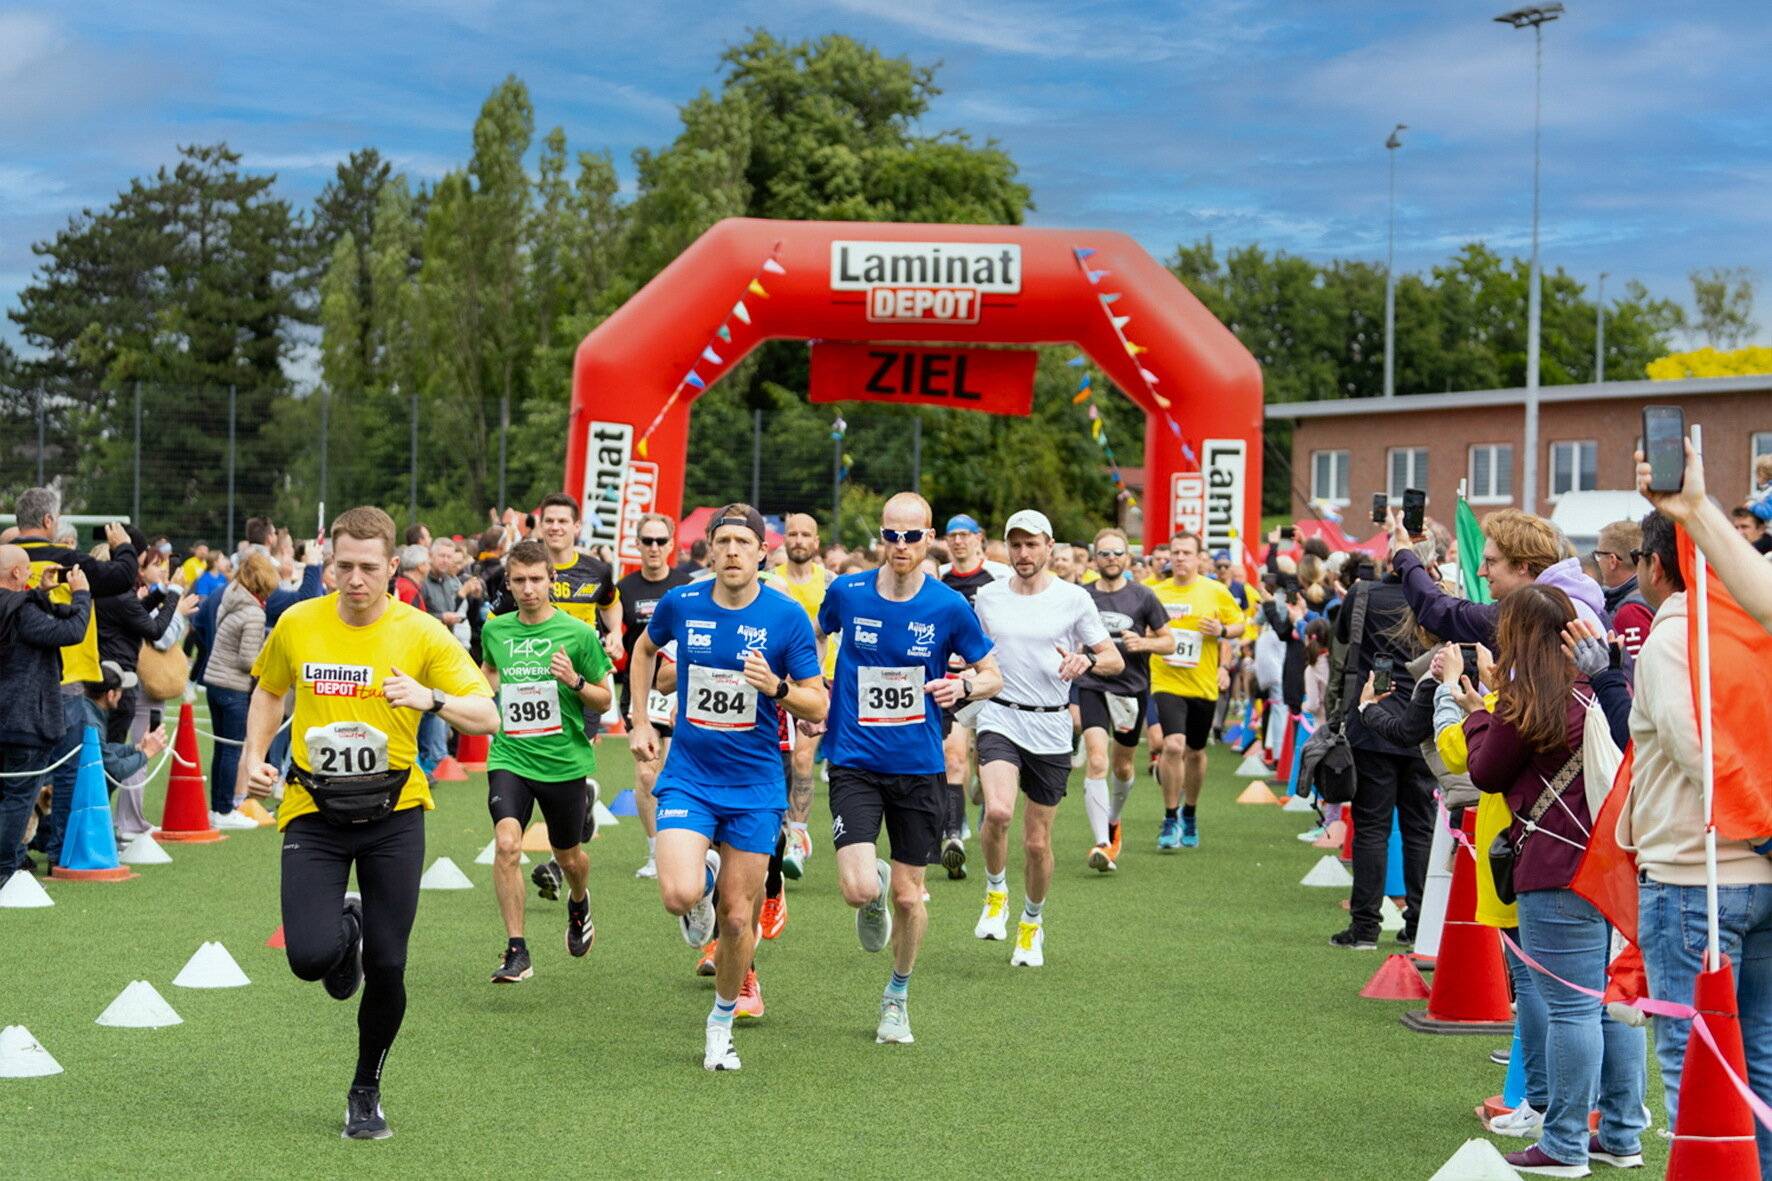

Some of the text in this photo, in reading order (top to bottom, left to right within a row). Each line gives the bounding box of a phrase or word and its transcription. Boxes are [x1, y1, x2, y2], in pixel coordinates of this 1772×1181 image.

[840, 247, 1014, 285] Laminat
[873, 288, 975, 319] DEPOT
[864, 351, 983, 400] ZIEL
[305, 664, 369, 683] Laminat
[503, 666, 551, 676] VORWERK
[315, 681, 356, 696] DEPOT
[697, 688, 746, 714] 284
[869, 686, 914, 710] 395
[509, 700, 551, 723] 398
[320, 746, 376, 772] 210
